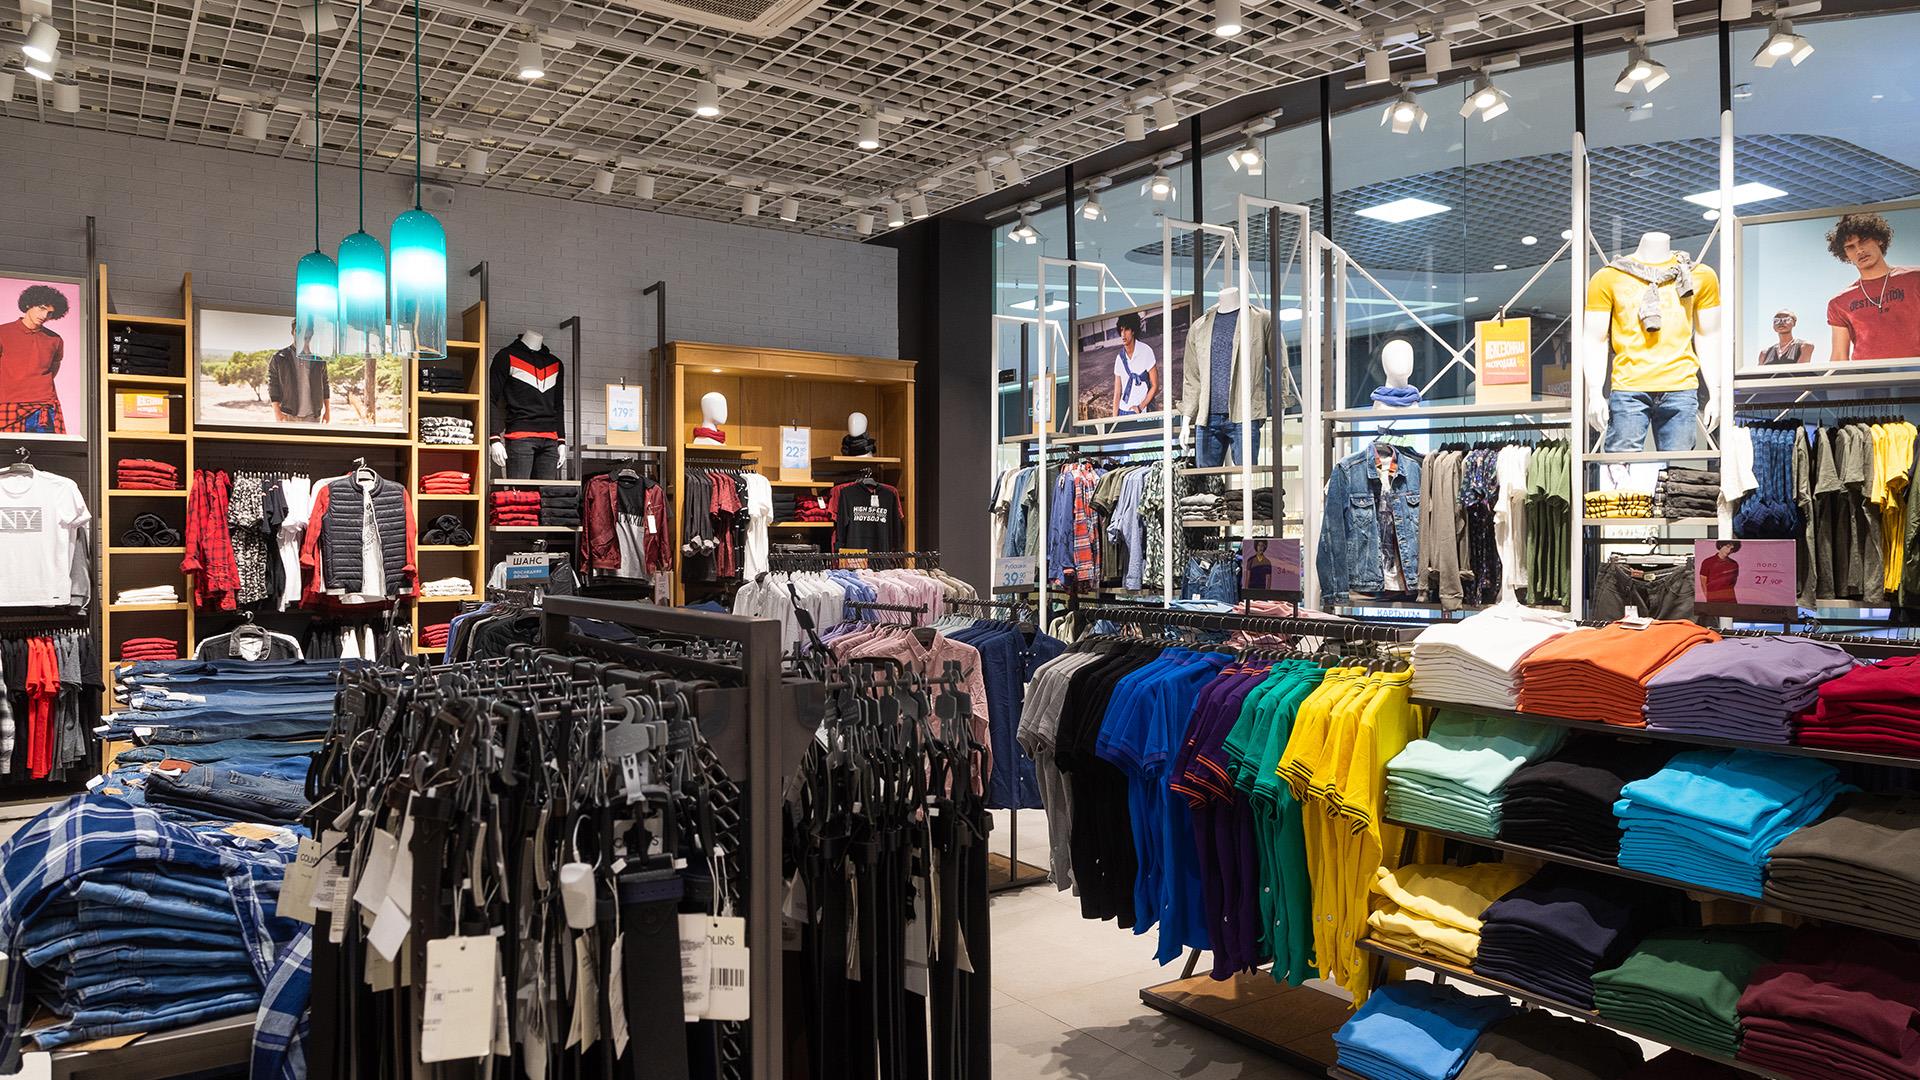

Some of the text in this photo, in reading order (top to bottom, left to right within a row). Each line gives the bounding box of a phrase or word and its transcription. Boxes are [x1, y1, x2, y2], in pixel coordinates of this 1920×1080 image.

[785, 446, 800, 458] 22
[0, 510, 39, 529] NY
[512, 557, 543, 566] ШАНС
[1003, 571, 1019, 586] 39
[1755, 575, 1768, 585] 27
